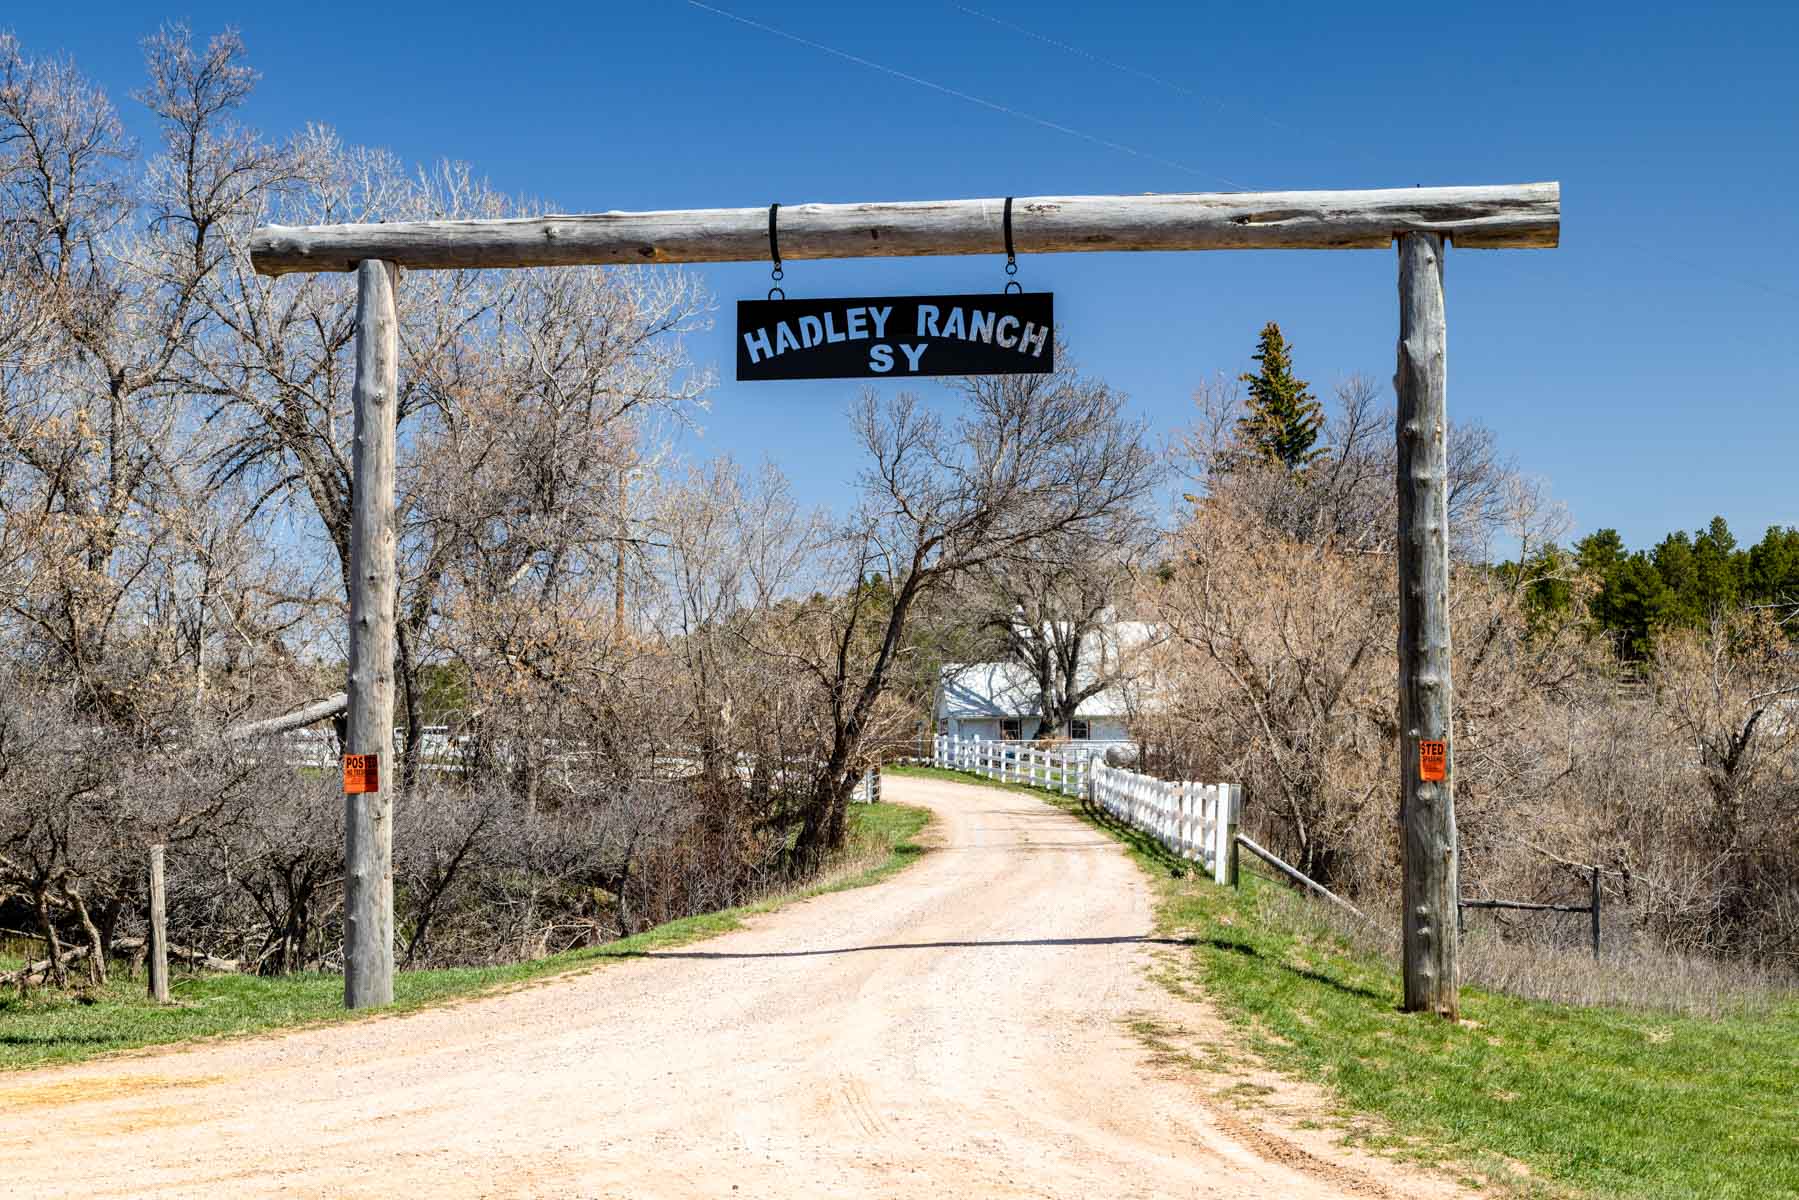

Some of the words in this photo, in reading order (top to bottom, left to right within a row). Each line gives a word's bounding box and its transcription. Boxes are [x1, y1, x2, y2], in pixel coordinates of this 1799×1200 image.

[743, 305, 893, 364] HADLEY
[916, 304, 1049, 358] RANCH
[868, 343, 929, 372] SY
